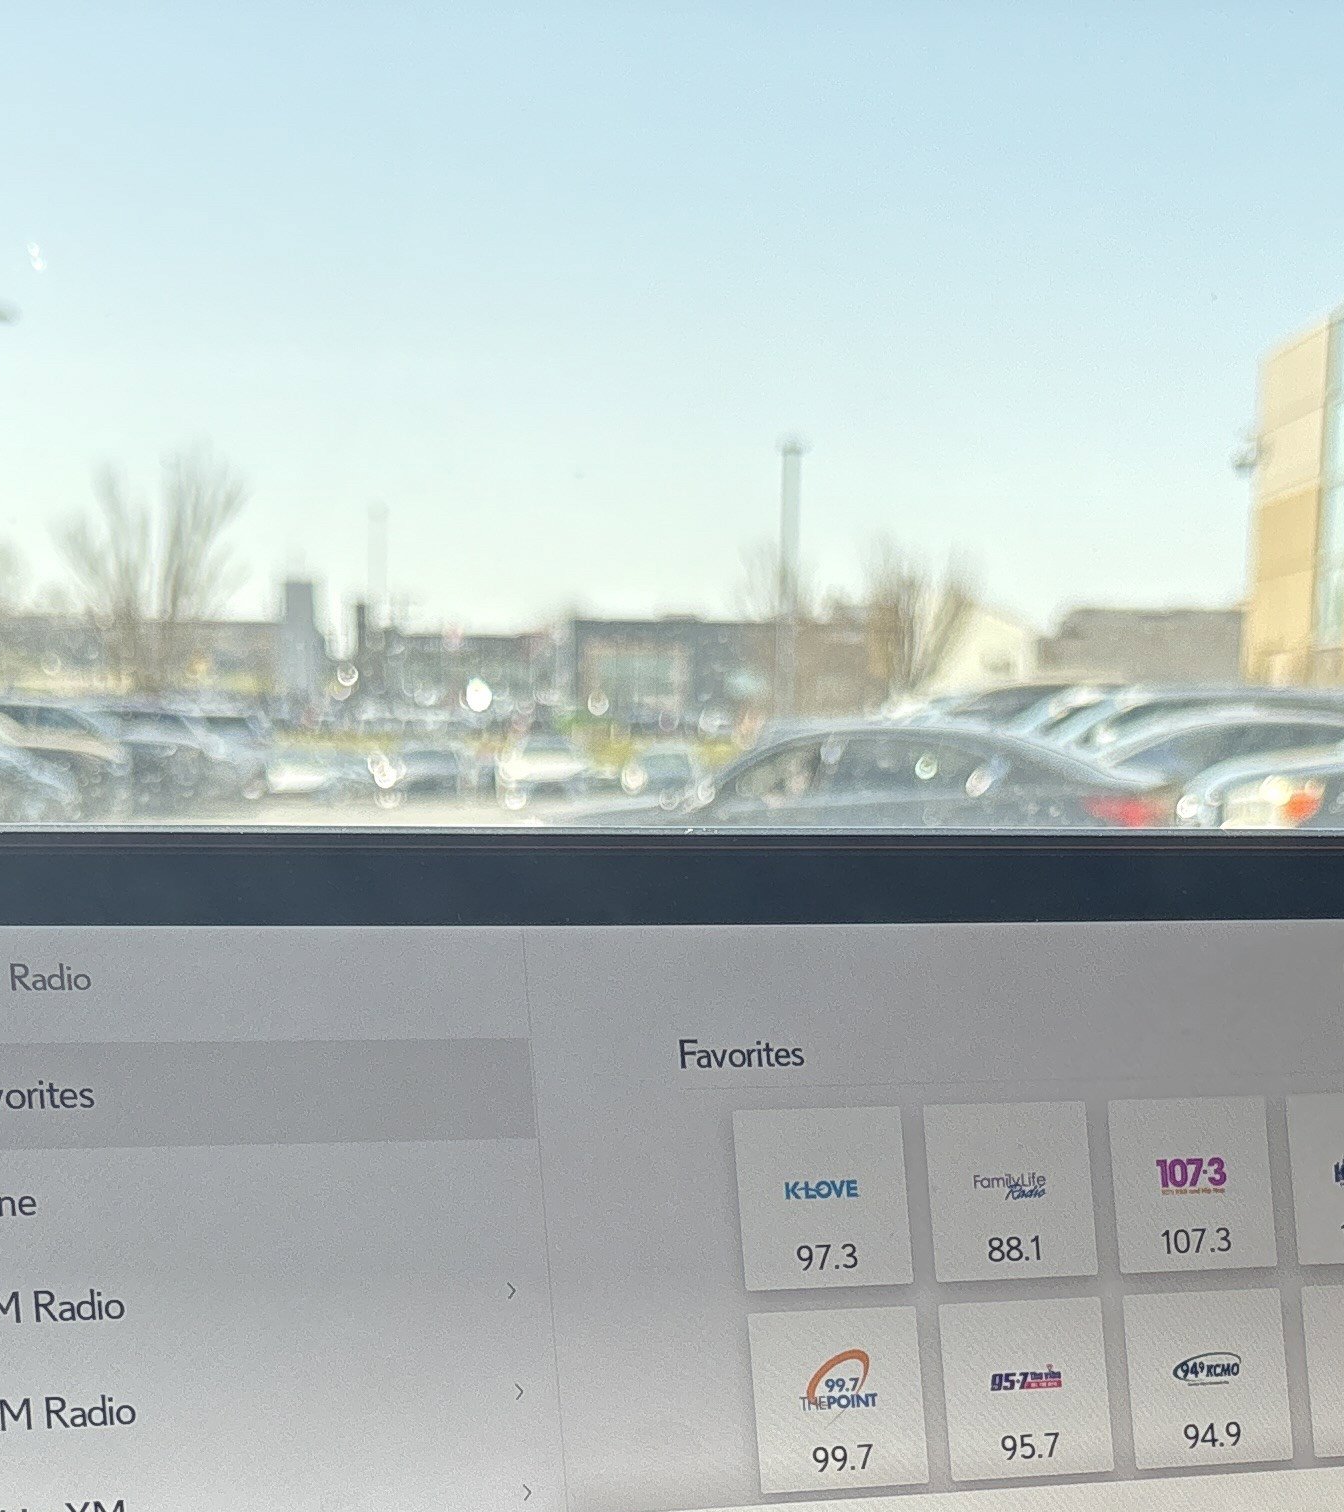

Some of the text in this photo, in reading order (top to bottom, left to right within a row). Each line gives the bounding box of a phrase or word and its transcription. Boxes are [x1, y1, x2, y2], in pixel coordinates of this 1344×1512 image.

[9, 962, 92, 992] Radio
[678, 1038, 805, 1069] Favorites
[988, 1235, 1042, 1263] 88.1
[1161, 1226, 1232, 1255] 107.3
[796, 1243, 859, 1271] 97.3
[33, 1288, 125, 1323] Radio
[1206, 1362, 1240, 1377] KCMO
[824, 1377, 859, 1393] 99.7
[44, 1394, 137, 1429] Radio
[1000, 1431, 1060, 1461] 95.7
[1183, 1421, 1242, 1449] 94.9
[812, 1443, 873, 1473] 99.7
